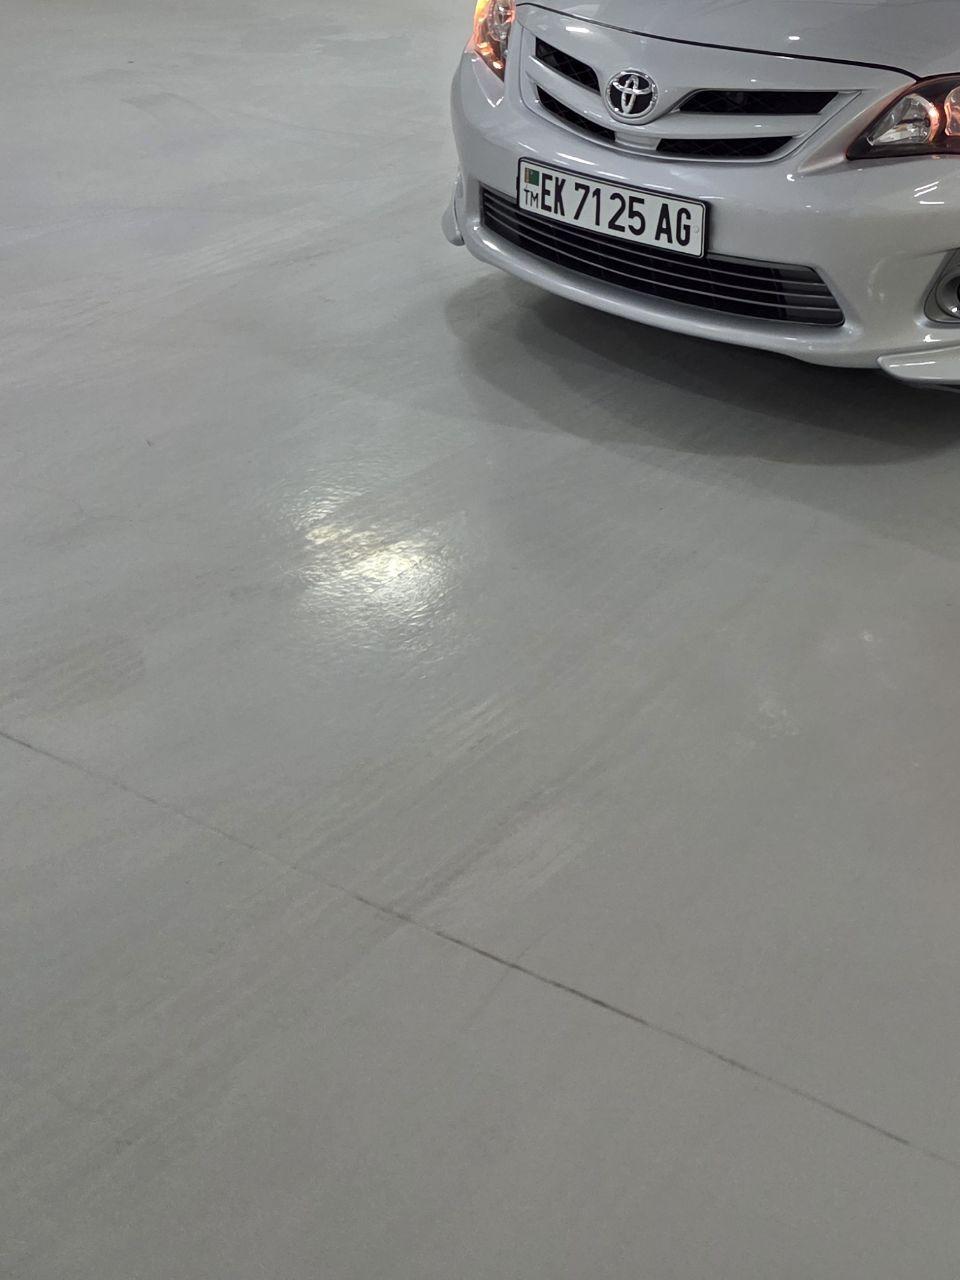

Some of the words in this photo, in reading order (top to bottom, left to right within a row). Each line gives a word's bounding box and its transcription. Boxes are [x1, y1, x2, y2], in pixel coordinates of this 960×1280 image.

[524, 189, 540, 208] TM
[541, 173, 566, 216] EK
[574, 182, 646, 236] 7125
[655, 203, 691, 247] AG
